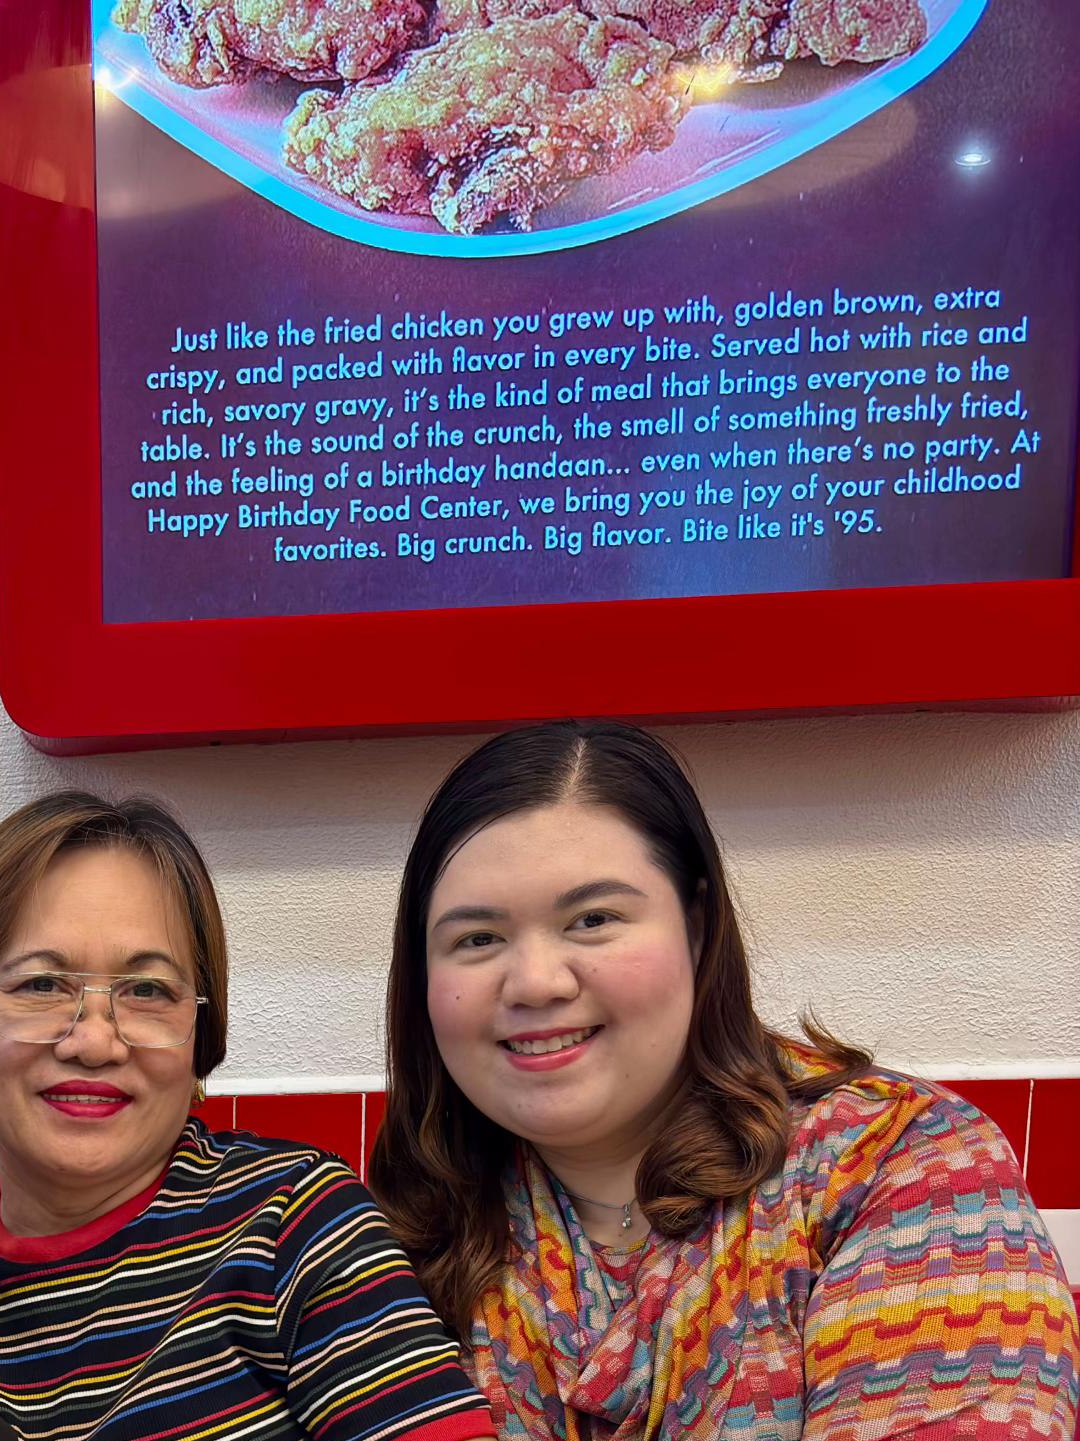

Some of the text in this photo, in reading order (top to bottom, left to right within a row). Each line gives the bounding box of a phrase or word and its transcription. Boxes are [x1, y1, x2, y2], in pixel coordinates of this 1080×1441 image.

[146, 316, 1028, 395] crispy, and packed with flavor in every bite. Served hot with rice and
[171, 286, 1000, 353] Just like the fried chicken you grew up with, golden brown, extra
[140, 389, 1028, 462] table. It's the sound of the crunch, the smell of something freshly fried,
[162, 355, 1010, 428] rich, savory gravy, it's the kind of meal that brings everyone to the
[131, 429, 1041, 499] and the feeling of a birthday handaan... even when there's no party. At
[148, 463, 1021, 538] Happy Birthday Food Center, we bring you the joy of your childhood
[274, 509, 883, 563] favorites. Big crunch. Big flavor. Bite like it's '95.
